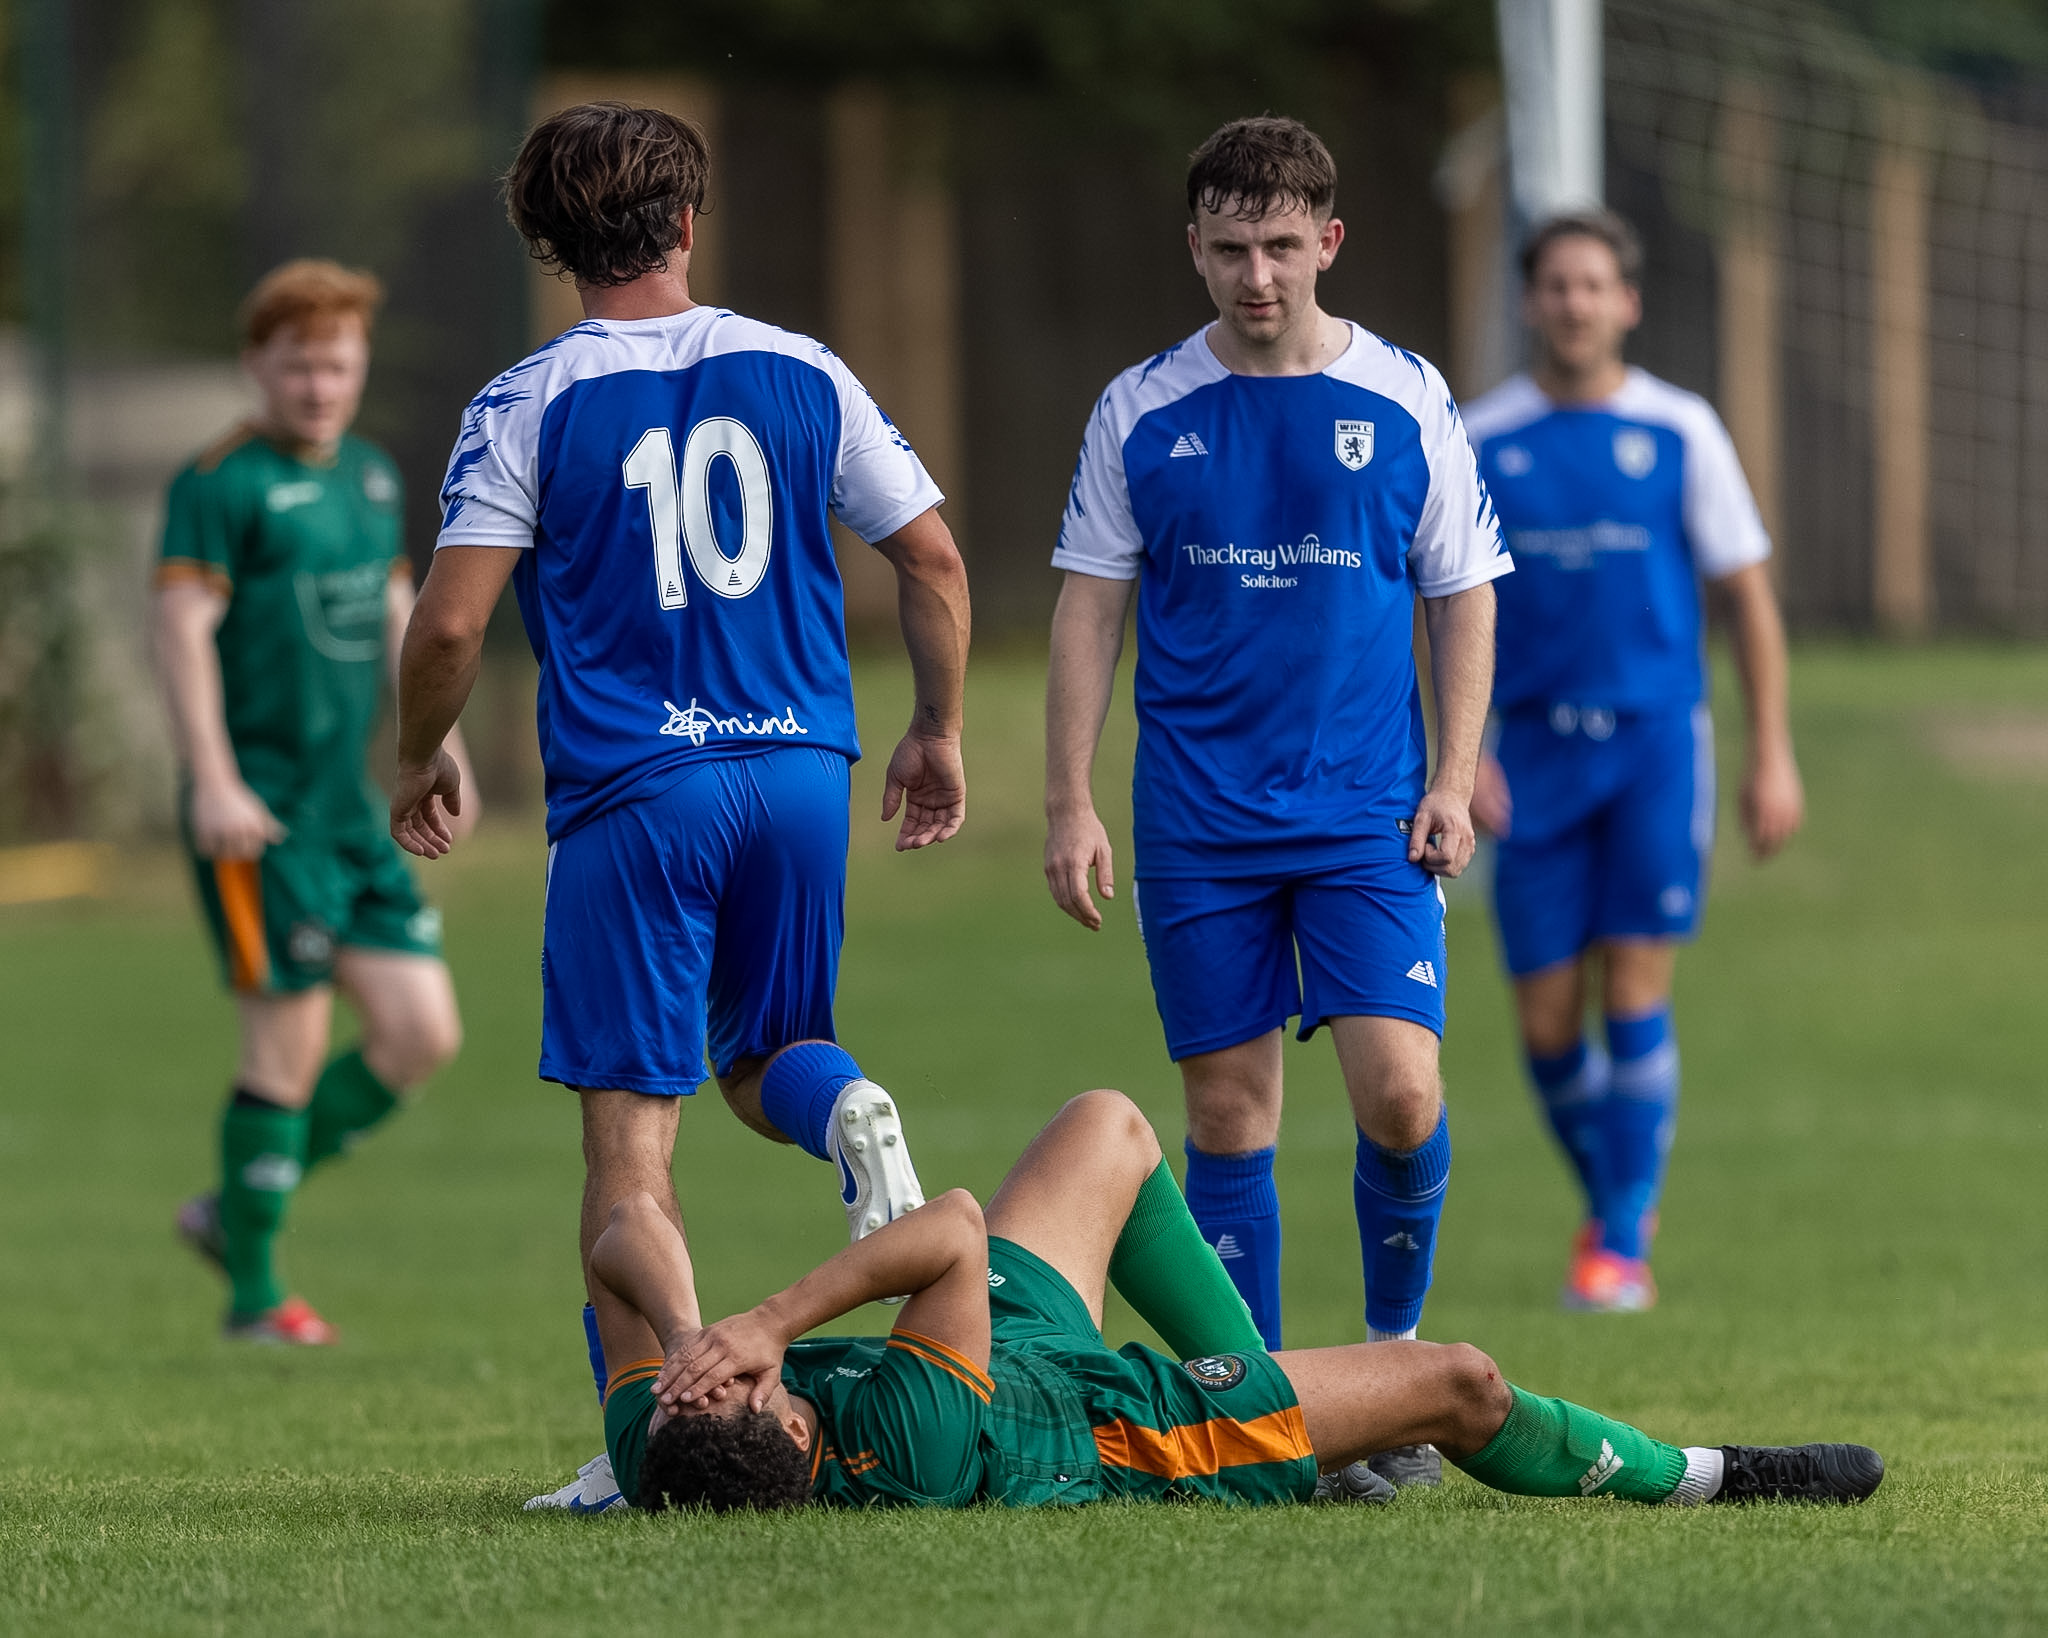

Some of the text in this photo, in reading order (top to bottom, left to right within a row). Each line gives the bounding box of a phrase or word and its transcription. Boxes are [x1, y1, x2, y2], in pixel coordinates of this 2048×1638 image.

[622, 416, 773, 610] 10
[1182, 542, 1362, 571] Thackray Williams
[1240, 574, 1298, 588] Solicitors
[716, 706, 808, 735] mind
